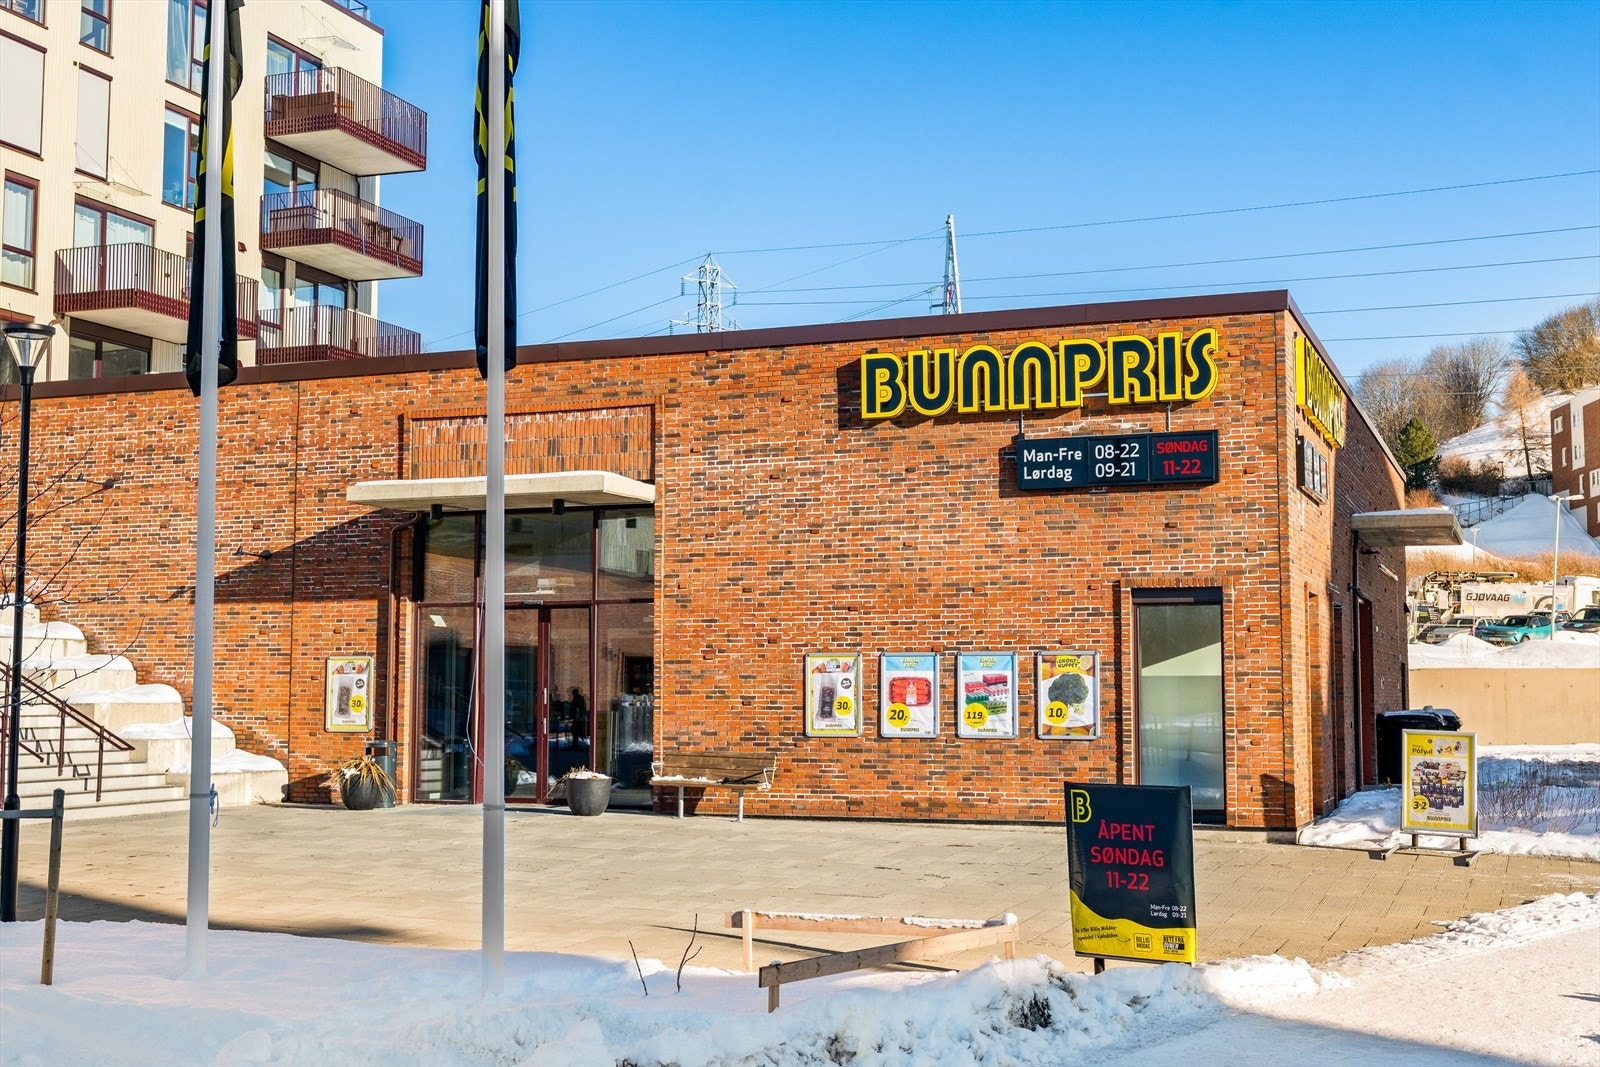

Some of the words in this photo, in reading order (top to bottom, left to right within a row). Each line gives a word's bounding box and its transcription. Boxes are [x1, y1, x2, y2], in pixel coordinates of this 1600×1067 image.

[861, 327, 1219, 420] BUNNPRIS
[1023, 448, 1083, 463] Man-Fre
[1095, 443, 1140, 460] 08-22
[1156, 439, 1208, 455] SØNDAG
[1023, 466, 1073, 482] Lørdag
[1095, 462, 1136, 478] 09-21
[1162, 459, 1201, 476] 11-22
[1465, 593, 1511, 602] GJØVAAG
[1097, 819, 1155, 842] ÅPENT
[1090, 846, 1164, 867] SØNDAG
[1106, 871, 1149, 891] 11-22
[1150, 911, 1168, 919] Lørdag
[1171, 911, 1187, 919] 09-21
